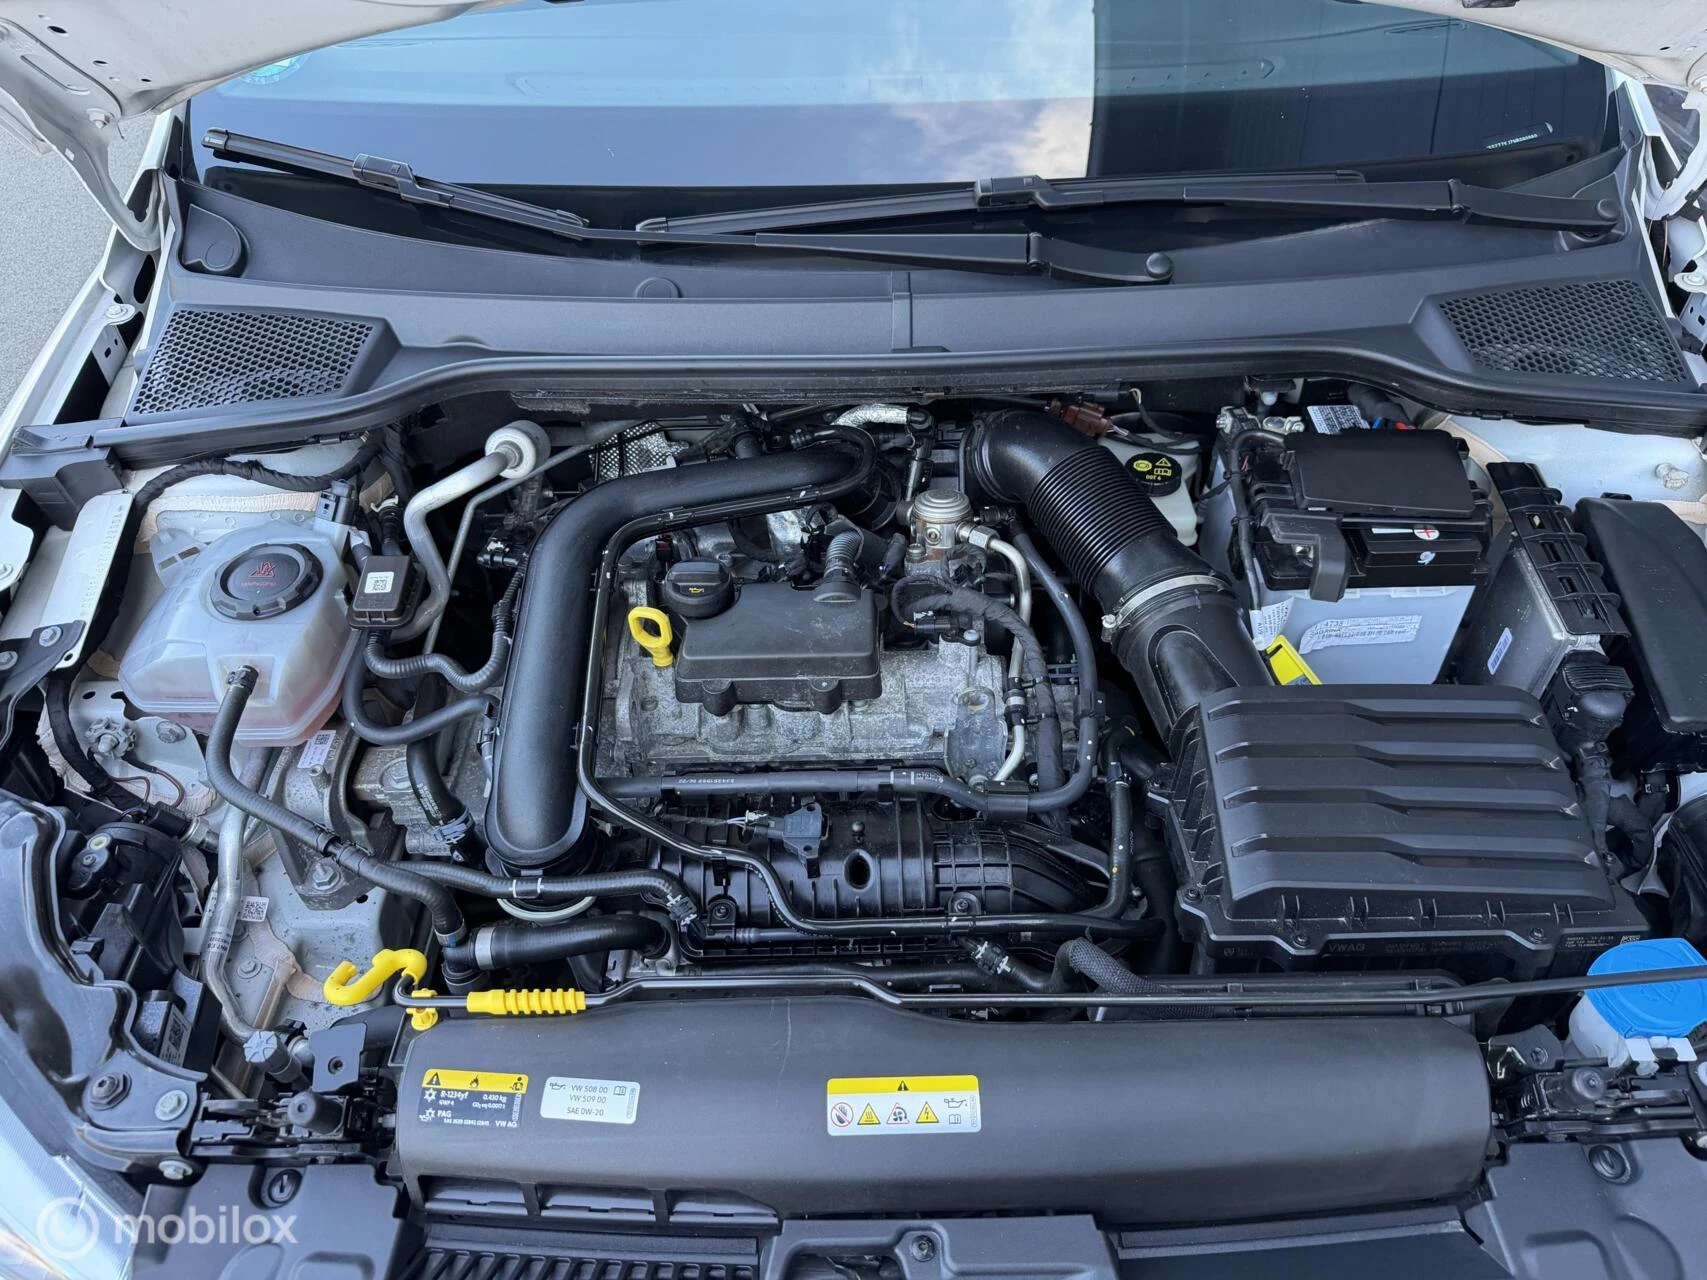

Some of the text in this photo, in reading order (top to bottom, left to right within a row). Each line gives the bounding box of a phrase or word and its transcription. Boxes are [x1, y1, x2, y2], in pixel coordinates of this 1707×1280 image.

[584, 1085, 598, 1093] 508
[598, 1086, 609, 1094] 00
[440, 1090, 469, 1101] R-1234yf
[569, 1094, 607, 1103] VW 509 00
[437, 1110, 452, 1118] PAG
[566, 1106, 605, 1117] SAE 0W-20
